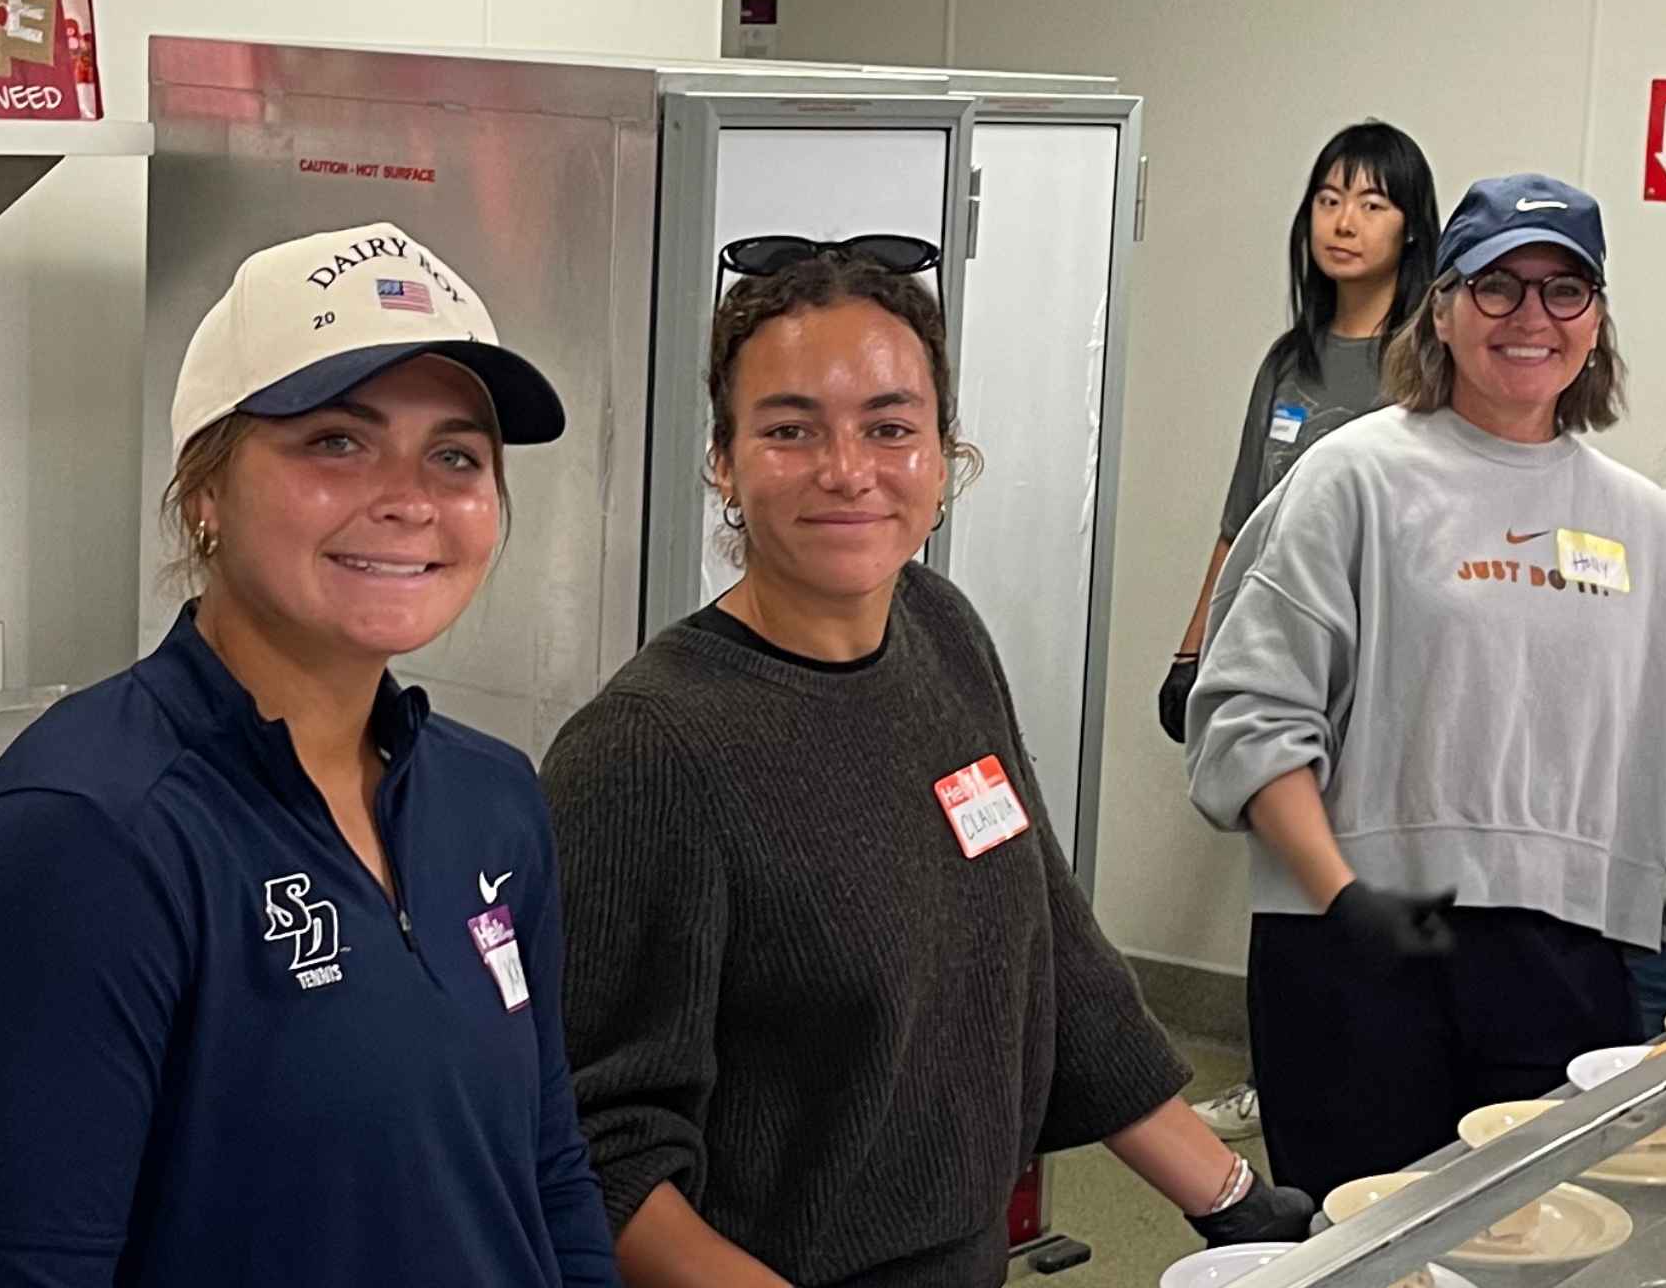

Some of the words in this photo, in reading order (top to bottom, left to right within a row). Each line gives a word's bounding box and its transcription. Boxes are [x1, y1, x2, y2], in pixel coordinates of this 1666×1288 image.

[299, 159, 349, 175] CAUTION
[356, 164, 379, 178] HOT
[383, 165, 436, 183] SURFACE
[306, 237, 409, 291] DAIRY
[312, 311, 336, 330] 20
[1457, 560, 1520, 584] JUST
[1530, 565, 1568, 591] DO
[263, 872, 339, 970] SD
